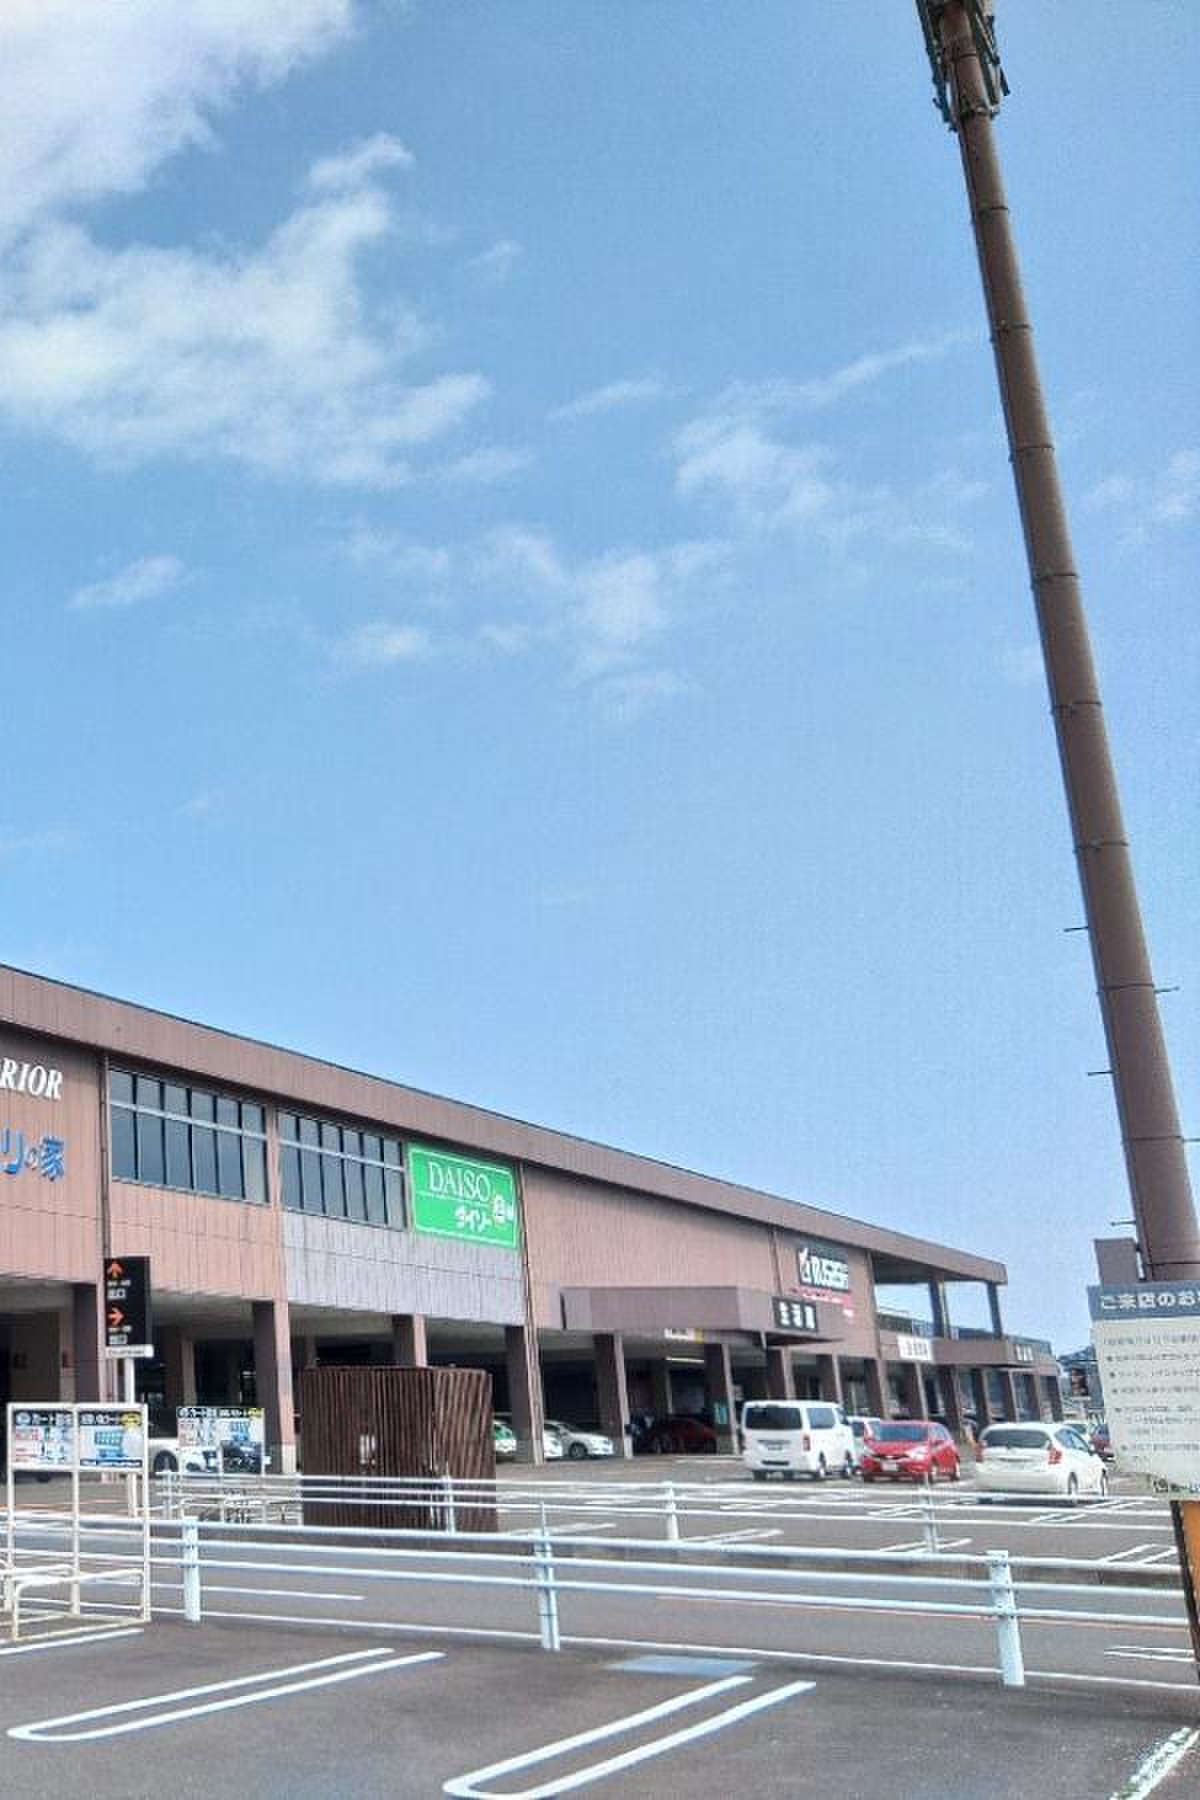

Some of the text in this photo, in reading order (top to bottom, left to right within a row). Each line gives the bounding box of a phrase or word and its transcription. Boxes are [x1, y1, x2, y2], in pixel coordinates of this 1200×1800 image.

[428, 1161, 491, 1203] DAISO
[1100, 1289, 1200, 1310] ご来店のお
